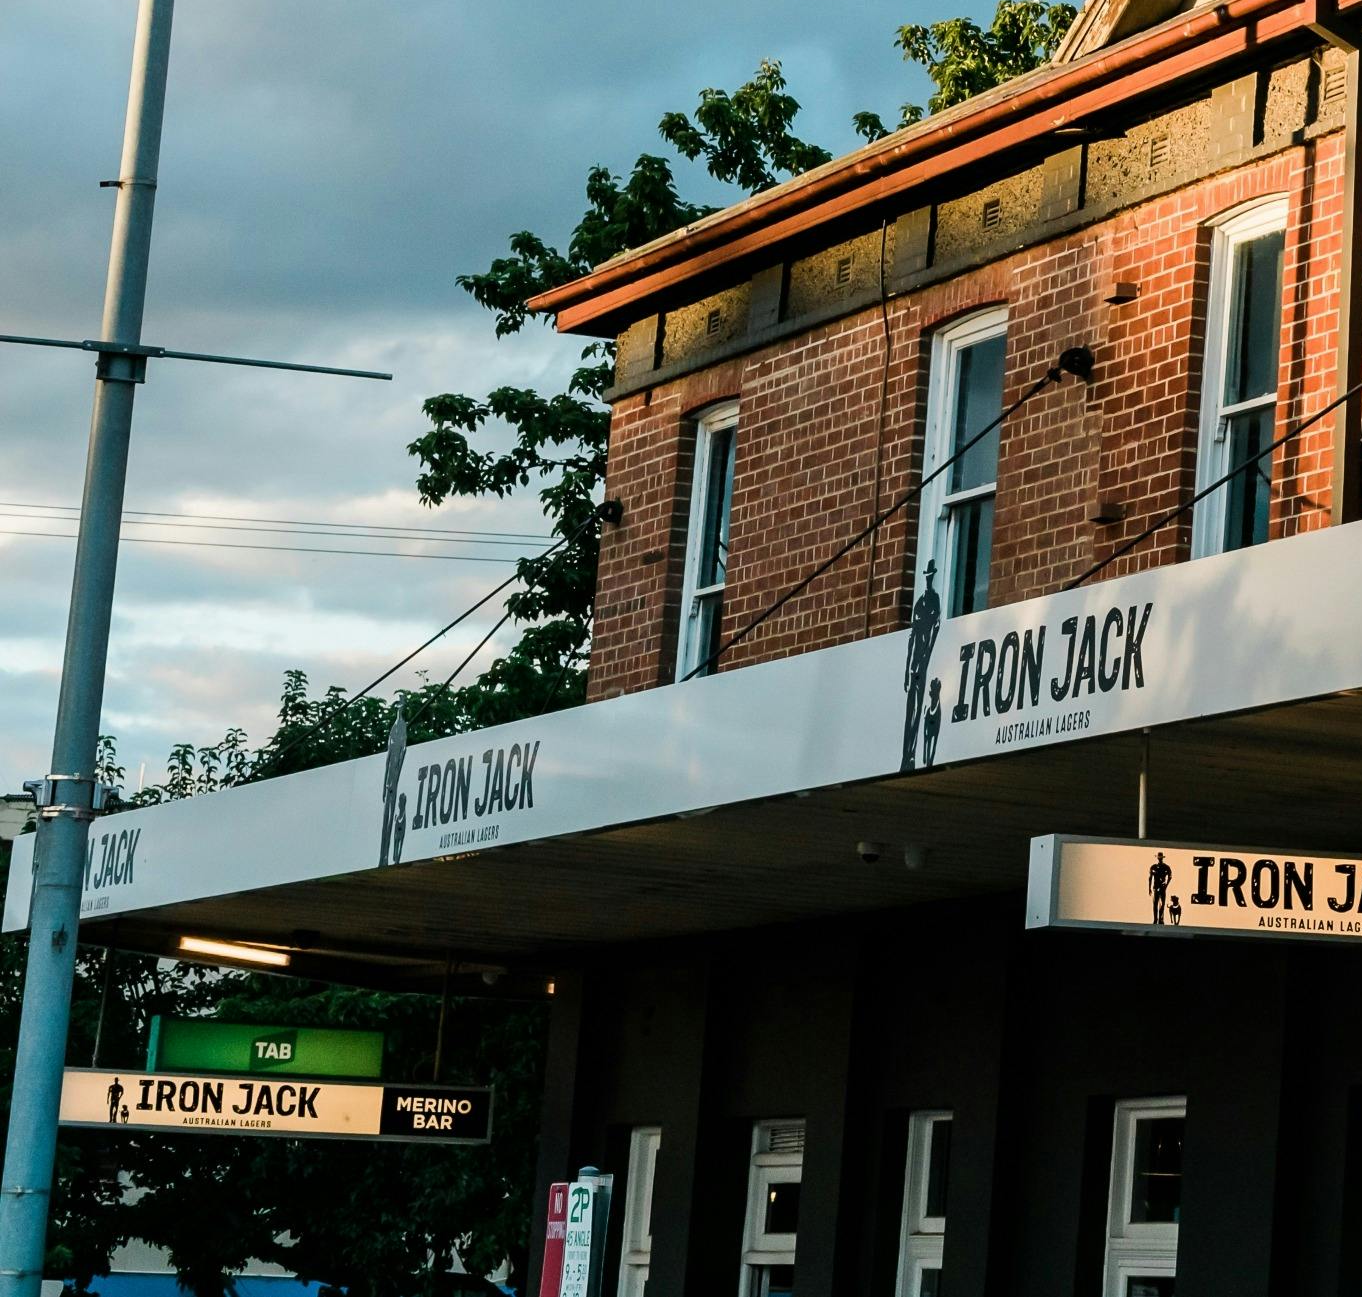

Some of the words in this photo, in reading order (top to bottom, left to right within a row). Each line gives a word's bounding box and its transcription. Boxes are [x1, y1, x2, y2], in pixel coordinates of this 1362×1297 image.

[951, 625, 1046, 723] IRON
[1050, 602, 1153, 702] JACK
[995, 717, 1052, 745] AUSTRALIAN
[1055, 711, 1091, 734] LAGERS
[412, 755, 473, 830] IRON
[474, 740, 540, 817] JACK
[439, 830, 475, 849] AUSTRALIAN
[477, 824, 500, 843] LAGERS
[93, 828, 141, 889] JACK
[1190, 856, 1313, 911] IRON
[1258, 916, 1333, 931] AUSTRALIAN
[255, 1041, 292, 1060] TAB
[136, 1079, 224, 1114] IRON
[232, 1083, 321, 1118] JACK
[396, 1096, 472, 1114] MERINO
[182, 1116, 236, 1127] AUSTRALIAN
[240, 1119, 272, 1128] LAGERS
[413, 1114, 453, 1130] BAR
[554, 1192, 563, 1214] NO
[570, 1187, 590, 1223] 2P
